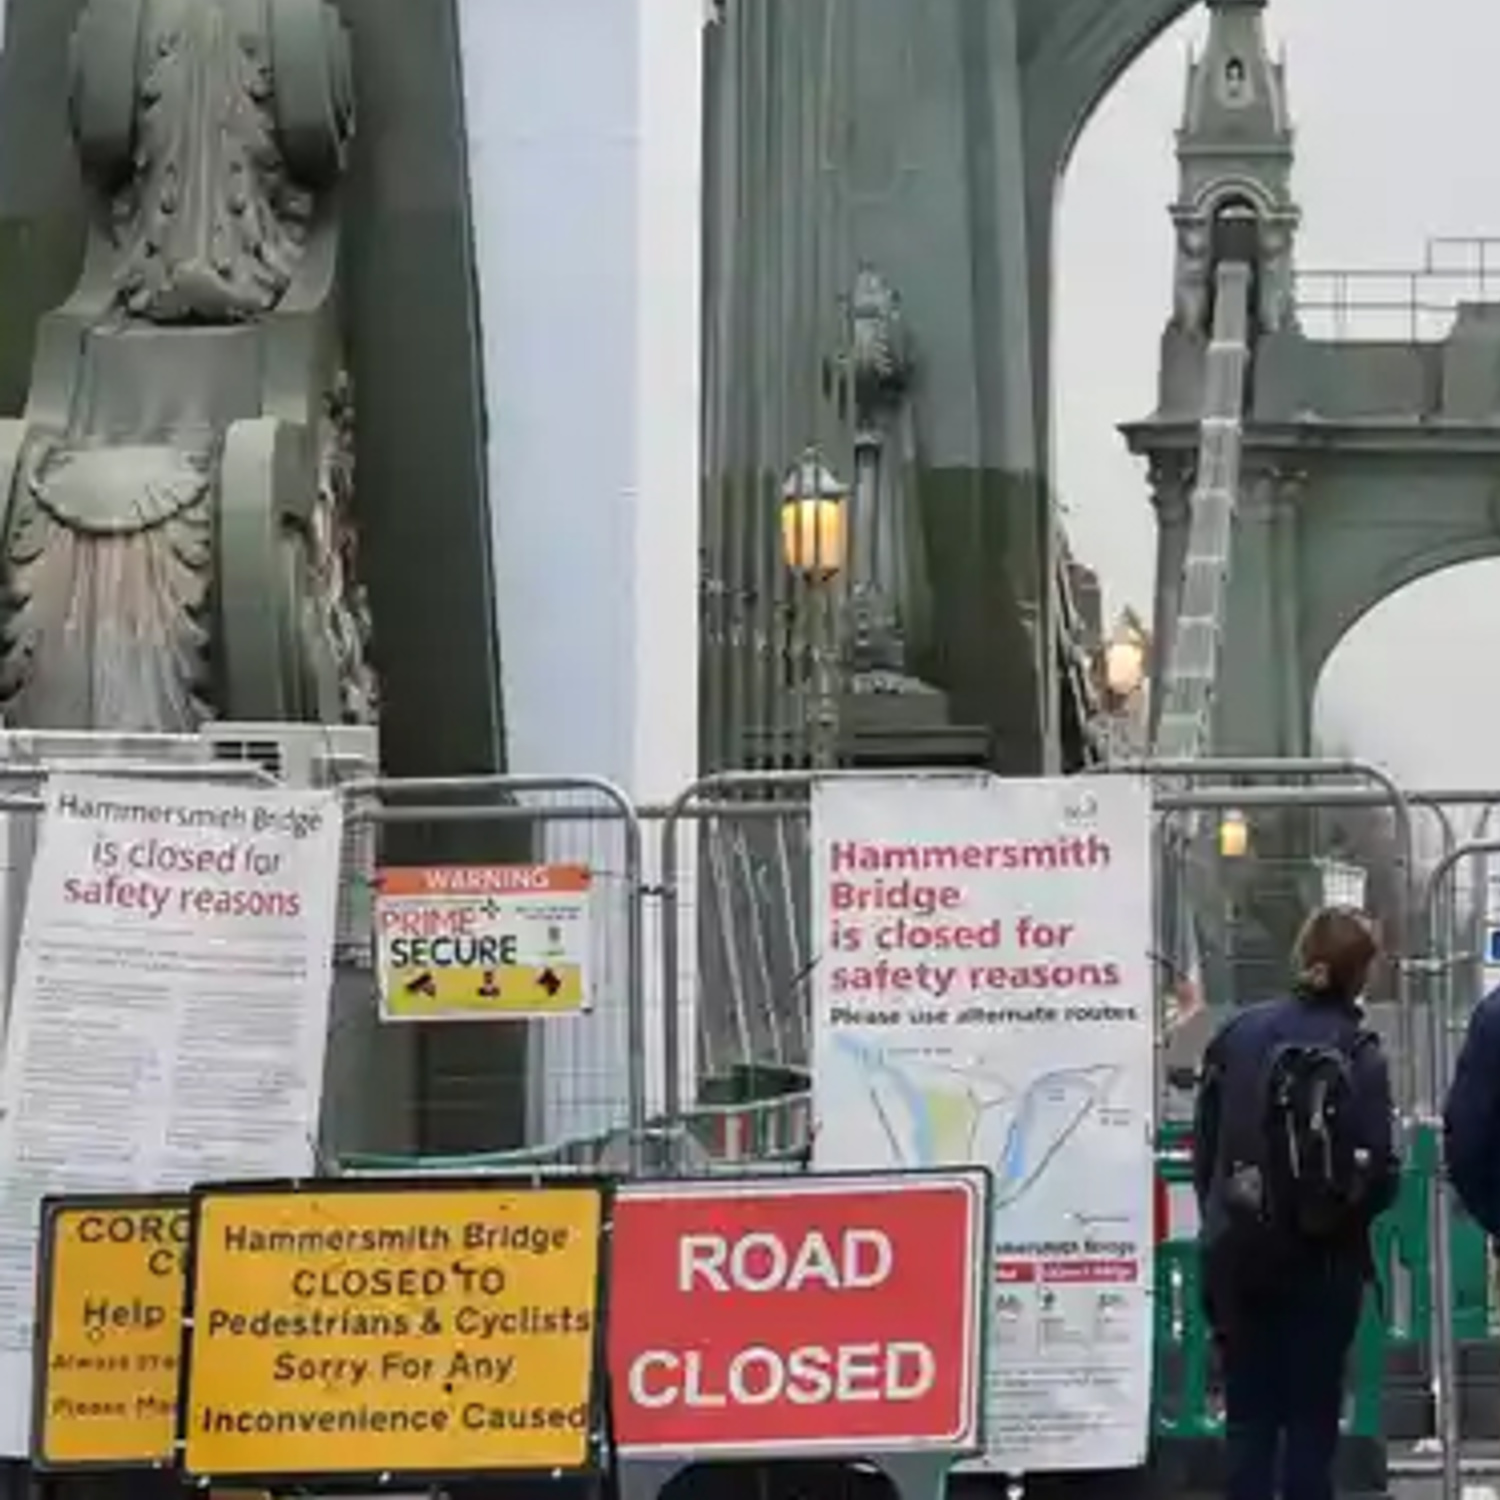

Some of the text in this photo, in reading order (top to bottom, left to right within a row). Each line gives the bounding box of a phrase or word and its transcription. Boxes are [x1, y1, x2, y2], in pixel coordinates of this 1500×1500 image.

[58, 794, 323, 839] Hammersmith Bridge
[93, 838, 282, 875] is closed for
[830, 835, 1111, 871] Hammersmith
[424, 867, 550, 889] WARNING
[63, 874, 300, 918] safety reasons
[830, 879, 961, 916] Bridge
[382, 908, 476, 935] PRIME
[831, 915, 1074, 950] is closed for
[390, 935, 518, 968] SECURE
[831, 960, 1121, 996] safety reasons
[829, 1006, 1137, 1024] Please use alternate routes
[224, 1220, 570, 1255] Hammersmith Bridge
[677, 1228, 893, 1293] ROAD
[292, 1267, 505, 1297] CLOSED TO
[84, 1298, 165, 1330] Help
[207, 1303, 592, 1338] Pedestrians & Cyclists
[272, 1350, 515, 1387] Sorry For Any
[628, 1341, 937, 1408] CLOSED
[201, 1403, 449, 1435] Inconvenience
[461, 1401, 587, 1432] Caused
